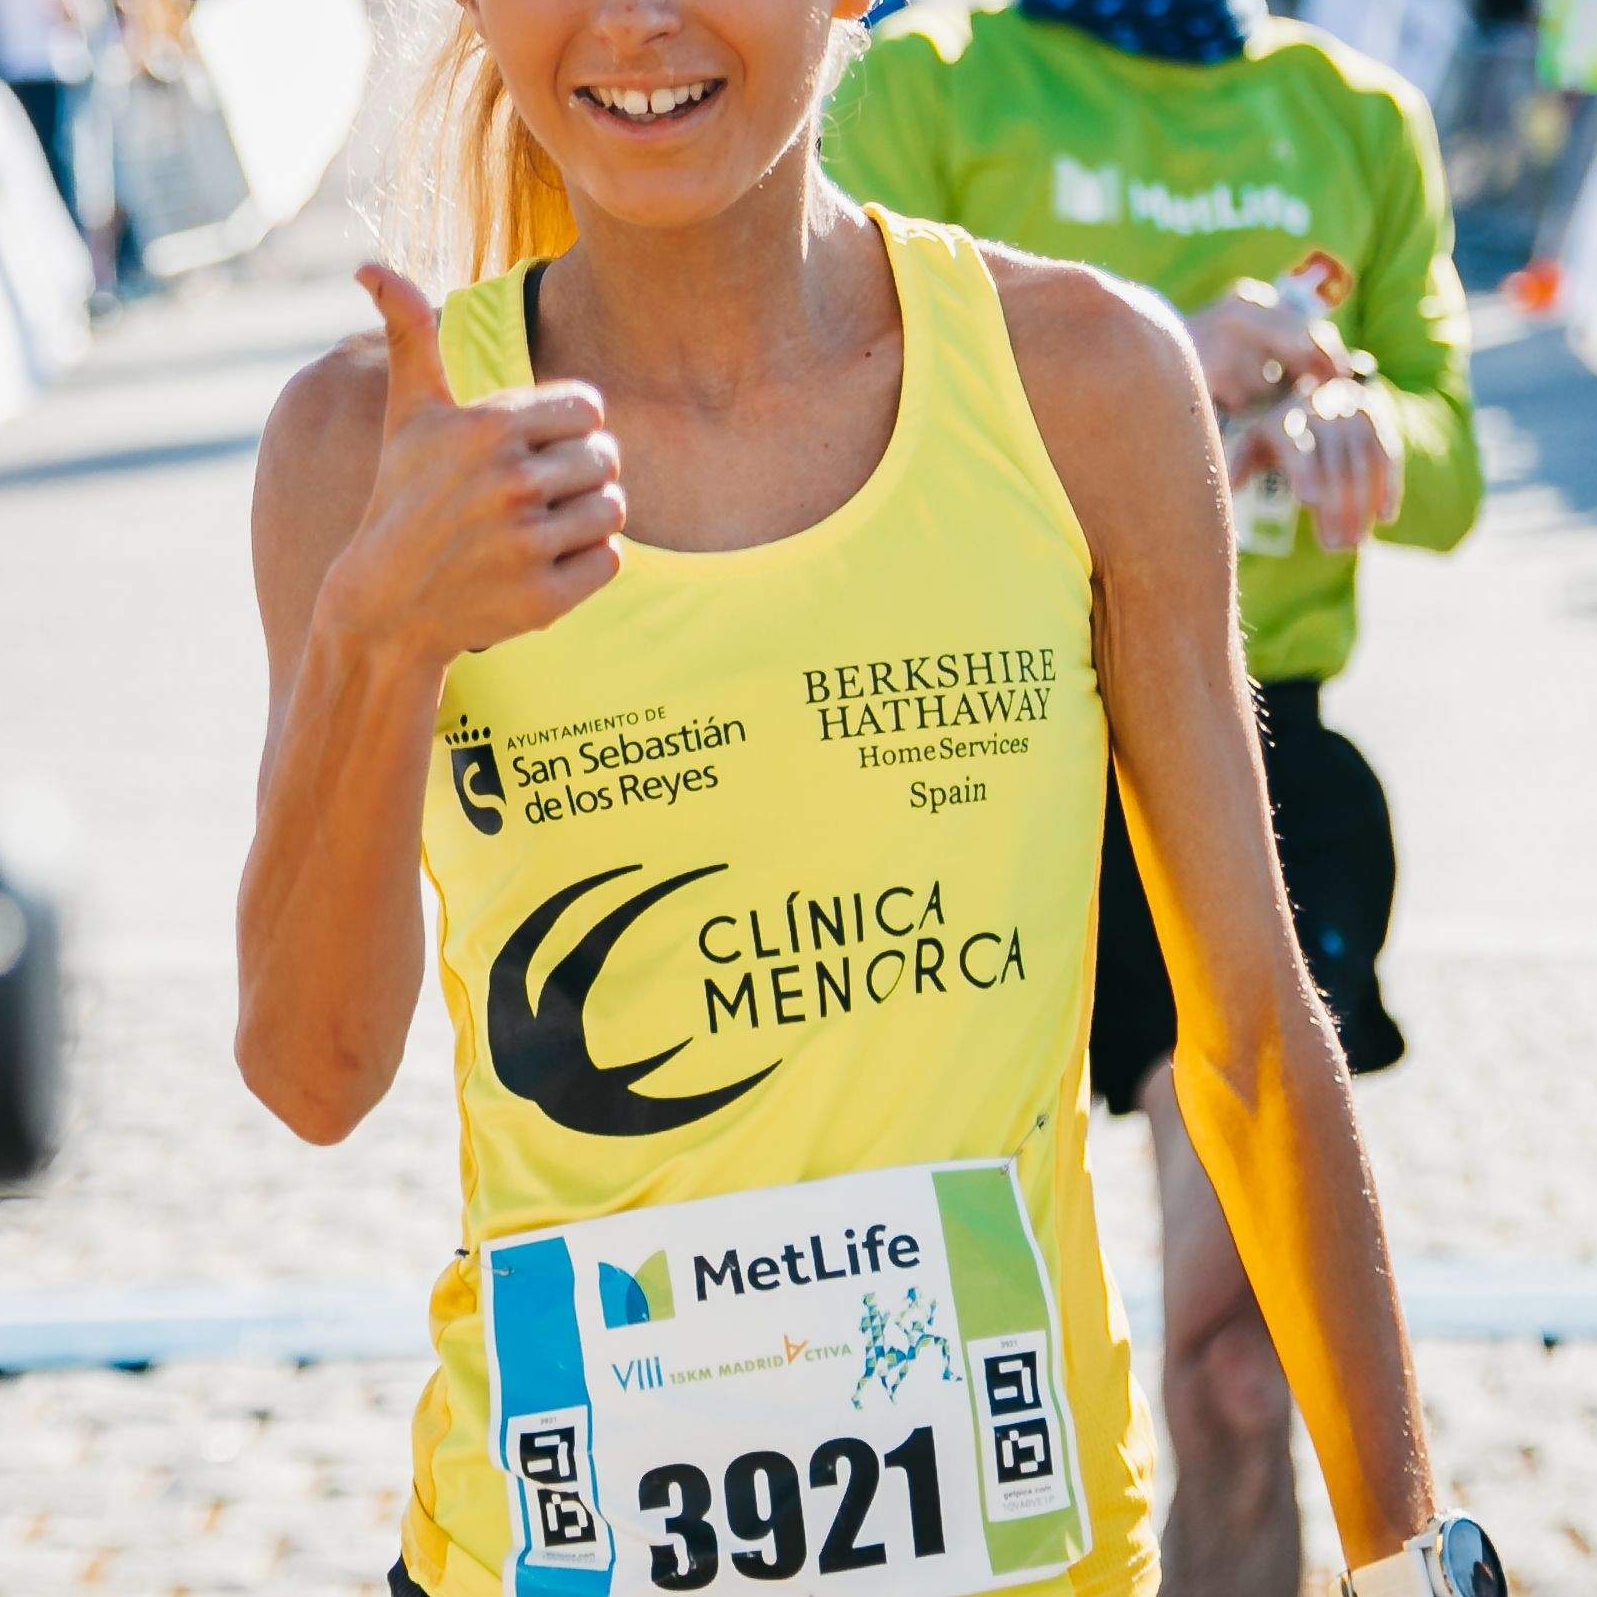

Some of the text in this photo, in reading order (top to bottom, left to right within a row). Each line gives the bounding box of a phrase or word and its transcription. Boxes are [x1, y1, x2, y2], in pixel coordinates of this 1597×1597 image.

[803, 648, 1056, 705] BERKSHIRE
[507, 706, 667, 751] AYUNTAMIENTO DE
[818, 688, 1051, 742] HATHAWAY
[513, 716, 746, 787] San Sebastián
[525, 764, 719, 824] de los Reyes
[910, 776, 987, 814] Spain
[699, 881, 946, 964] CLÍNICA
[704, 926, 1026, 1034] MENORCA
[693, 1224, 921, 1302] MetLife
[612, 1356, 664, 1392] VIII
[670, 1368, 712, 1384] 15KM
[718, 1355, 784, 1376] MADRID
[638, 1426, 947, 1591] 3921
